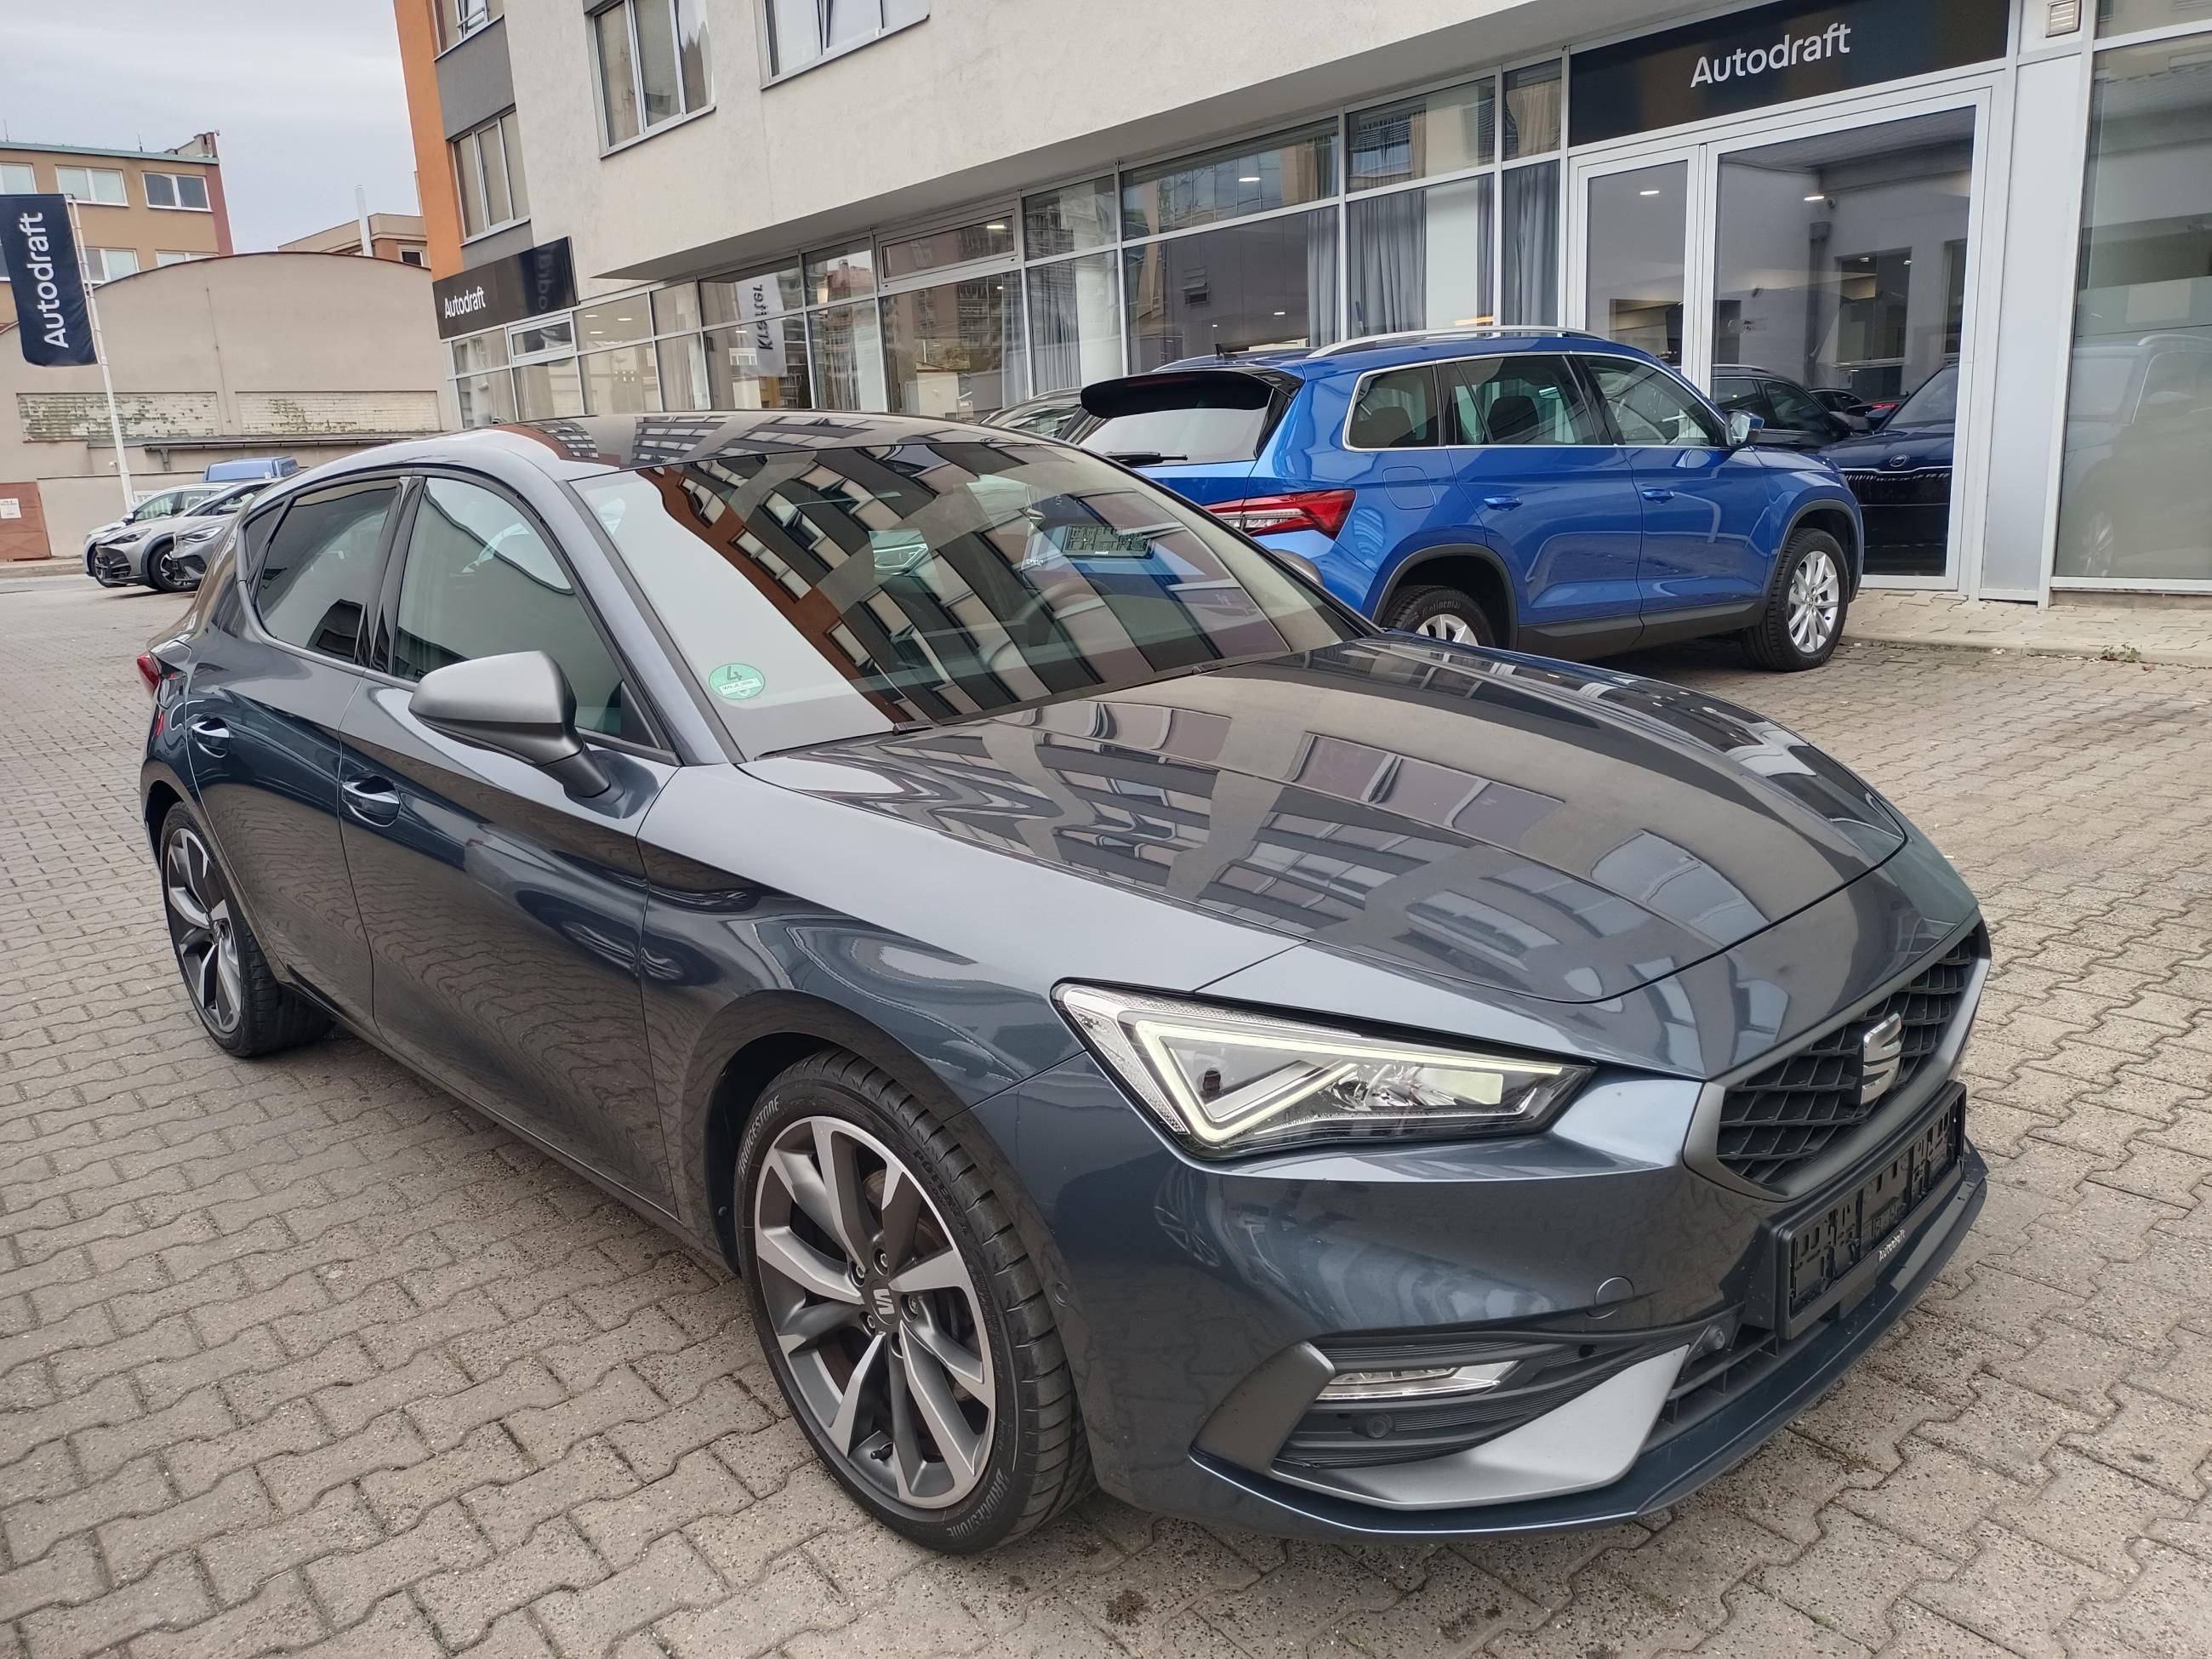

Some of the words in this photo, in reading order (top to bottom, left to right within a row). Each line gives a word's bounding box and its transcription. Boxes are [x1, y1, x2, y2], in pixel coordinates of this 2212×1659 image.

[1690, 23, 1850, 88] Autodraft
[20, 213, 69, 348] Autodraft
[445, 286, 486, 318] Autodraft
[738, 1094, 779, 1181] BRIDGESTONE
